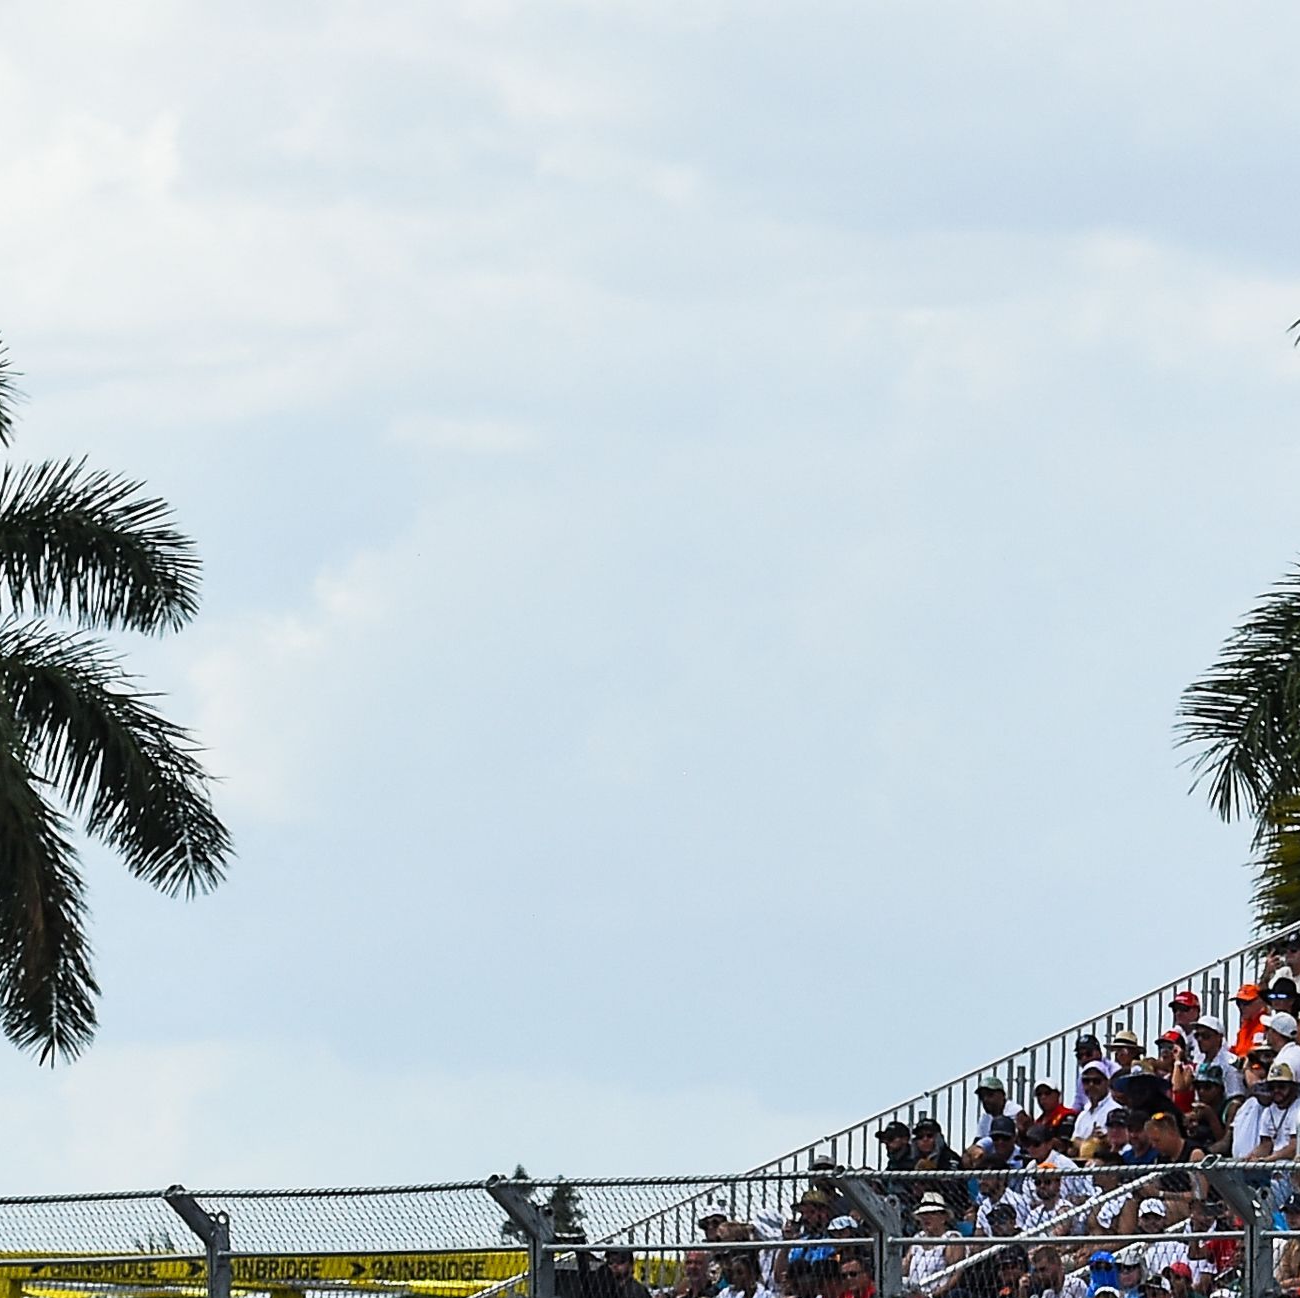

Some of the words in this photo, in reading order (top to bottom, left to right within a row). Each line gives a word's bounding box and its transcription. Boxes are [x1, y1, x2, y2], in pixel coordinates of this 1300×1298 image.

[50, 1262, 158, 1278] GAINBRIDGE
[230, 1257, 323, 1280] INBRIDGE
[372, 1258, 488, 1281] GAINBRIDGE
